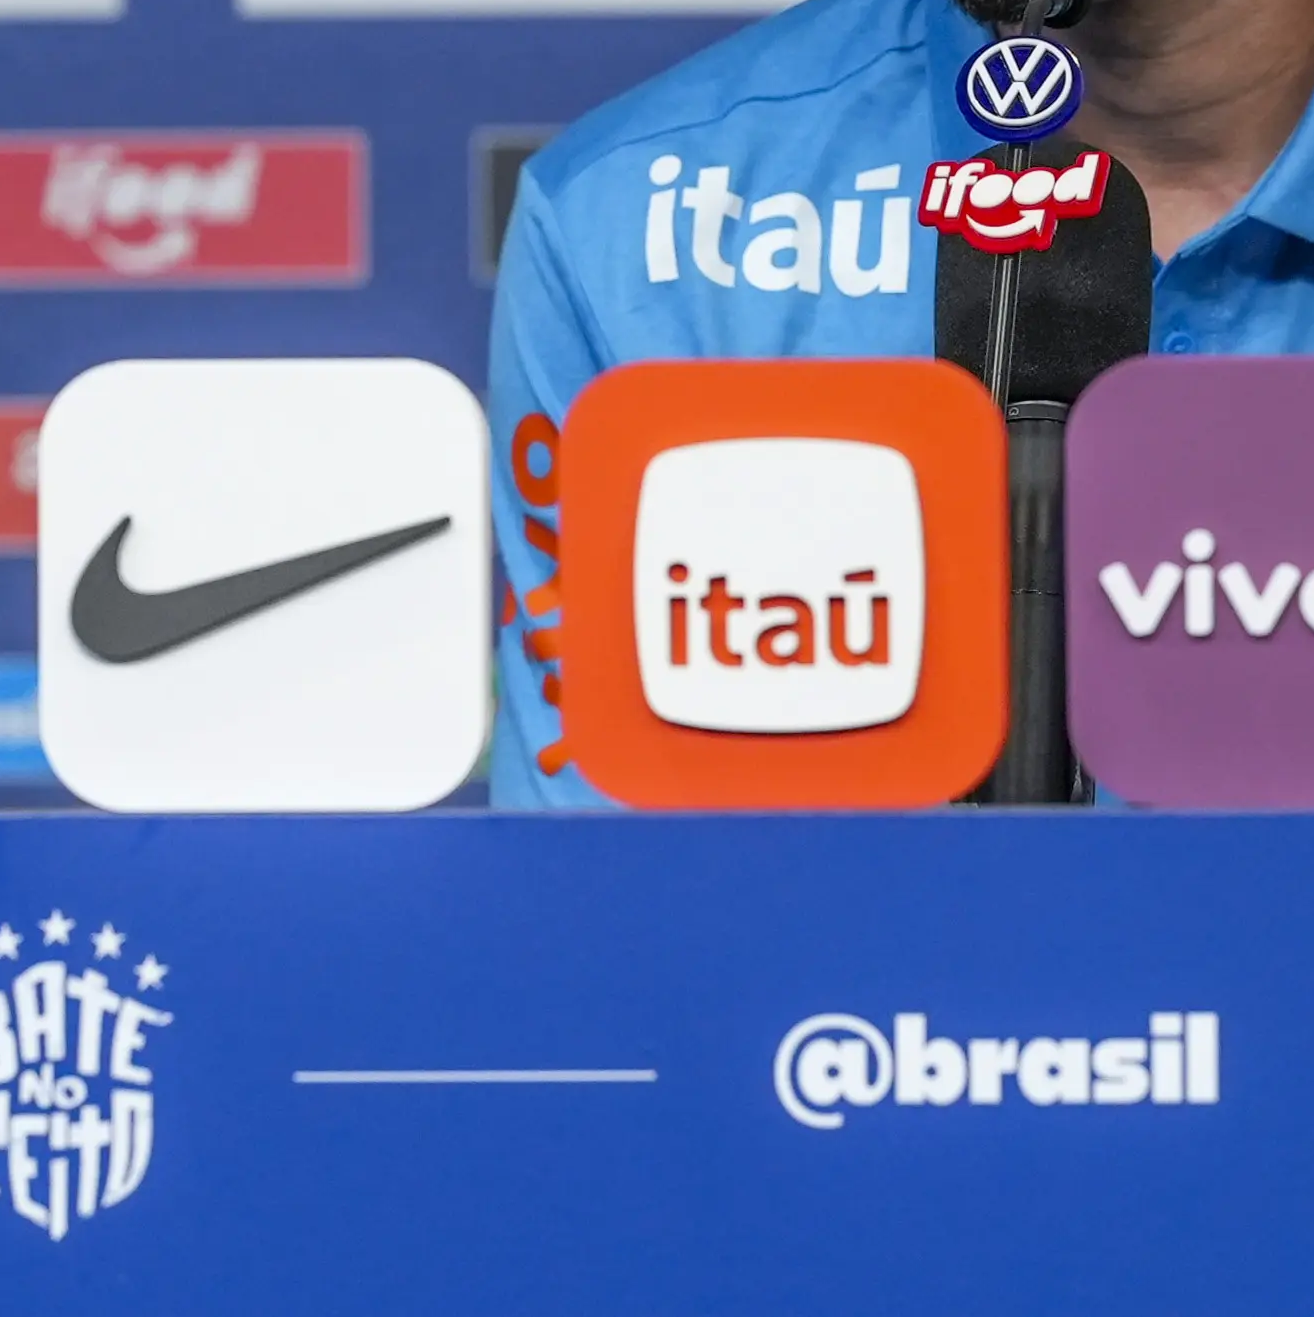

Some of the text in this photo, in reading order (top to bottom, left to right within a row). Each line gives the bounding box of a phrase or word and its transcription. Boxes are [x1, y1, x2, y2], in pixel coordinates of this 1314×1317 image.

[645, 156, 910, 296] itaú
[925, 154, 1099, 218] ifood
[666, 562, 891, 669] itaú
[19, 1063, 87, 1109] NO
[775, 1013, 1218, 1128] @brasil
